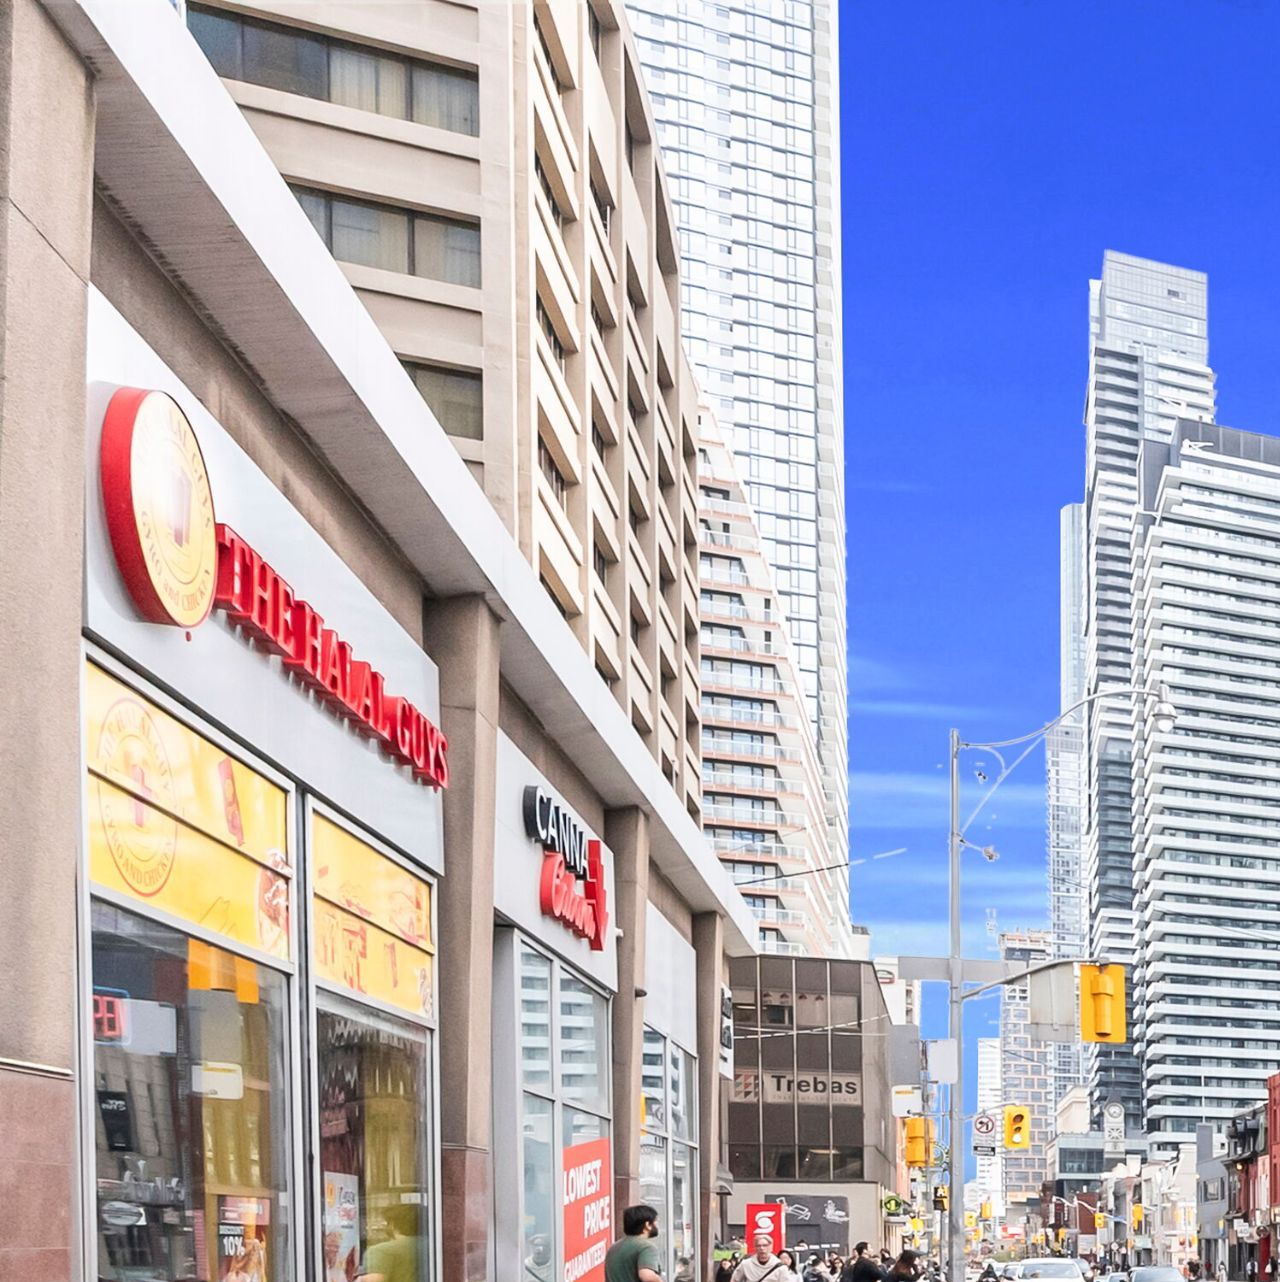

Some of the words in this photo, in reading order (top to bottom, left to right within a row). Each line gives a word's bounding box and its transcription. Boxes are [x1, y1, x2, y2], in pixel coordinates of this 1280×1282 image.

[217, 523, 295, 658] THE
[300, 600, 391, 741] HALAL
[396, 696, 449, 789] GUYS
[530, 786, 597, 881] CANNA
[771, 1075, 857, 1094] Trebas
[564, 1159, 602, 1205] LOWEST
[584, 1196, 610, 1238] PRICE
[223, 1236, 245, 1256] 10%
